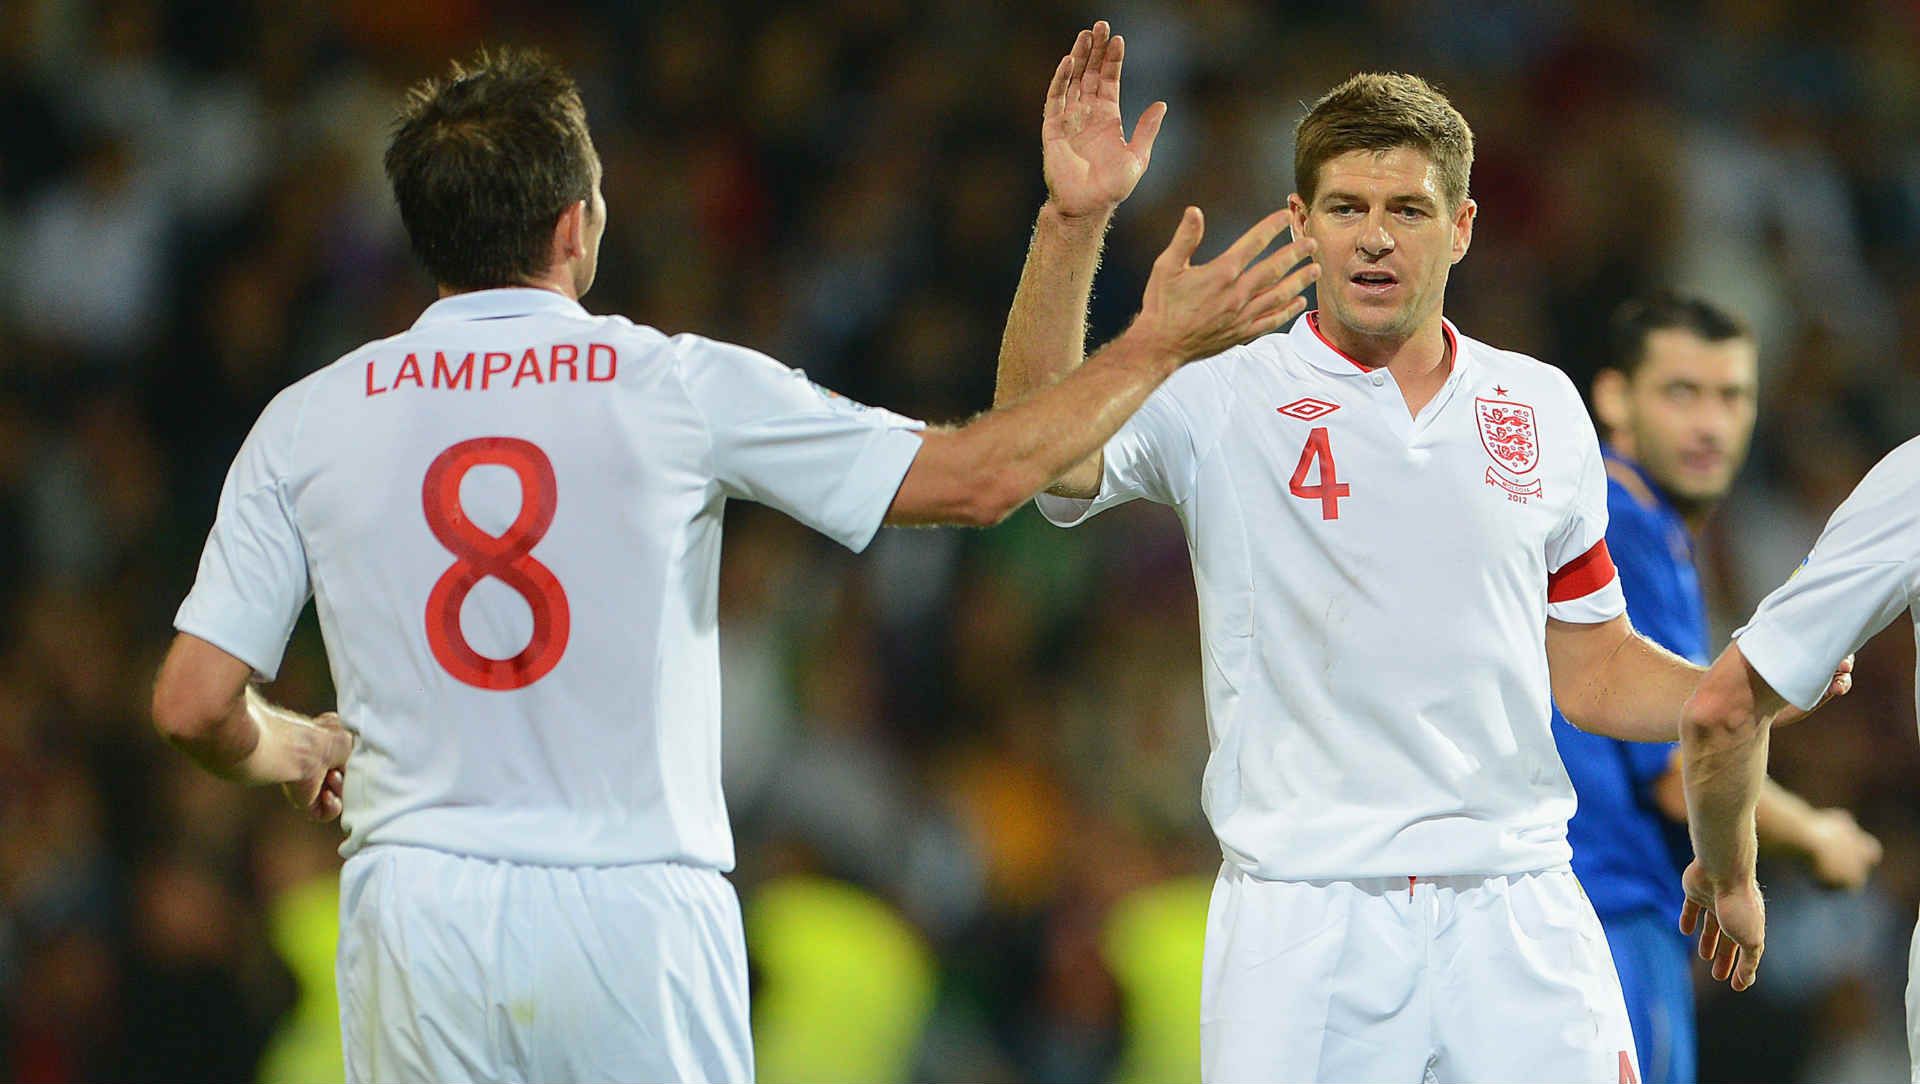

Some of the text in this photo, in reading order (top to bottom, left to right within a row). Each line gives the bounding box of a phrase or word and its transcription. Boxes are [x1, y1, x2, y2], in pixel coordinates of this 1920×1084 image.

[366, 343, 617, 397] LAMPARD
[1288, 427, 1350, 520] 4
[1507, 493, 1528, 504] 2012
[422, 437, 570, 692] 8
